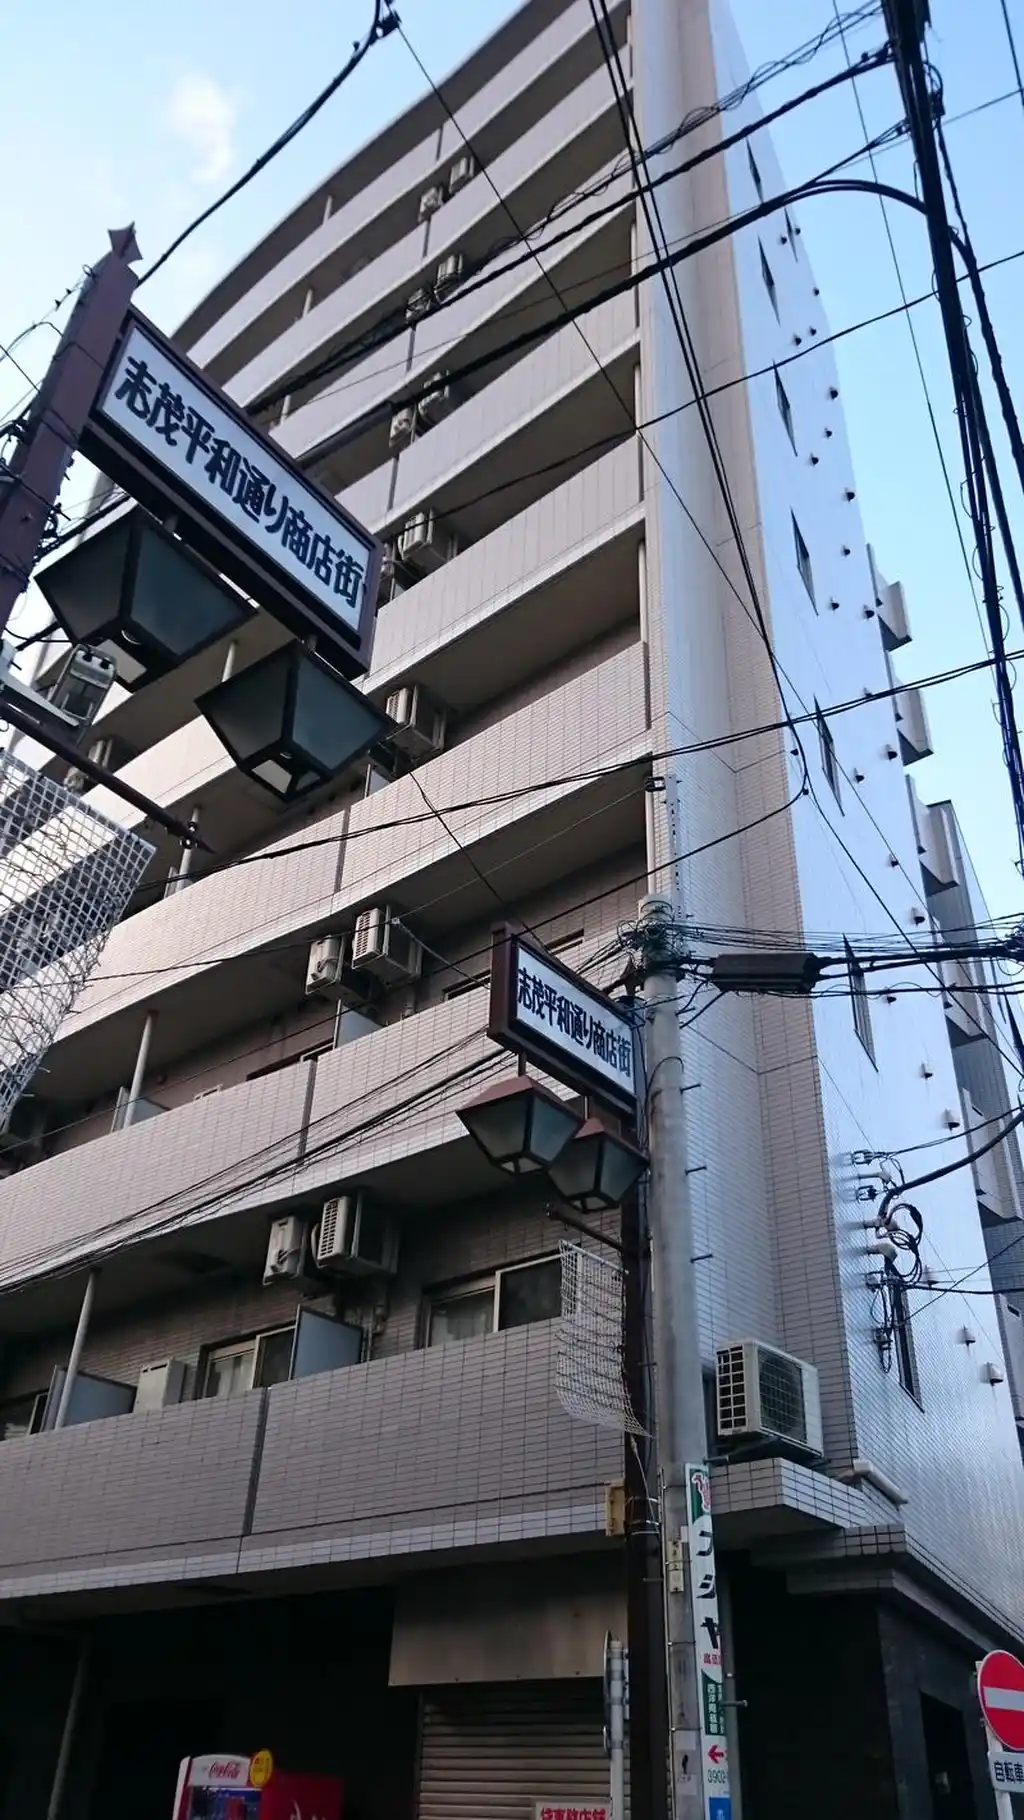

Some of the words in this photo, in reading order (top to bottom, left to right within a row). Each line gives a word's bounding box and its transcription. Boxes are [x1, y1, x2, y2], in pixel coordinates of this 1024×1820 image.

[115, 356, 364, 608] 志茂平和通り商店街
[518, 967, 632, 1077] 志茂平和通り商店街
[994, 1760, 1024, 1784] 自転車
